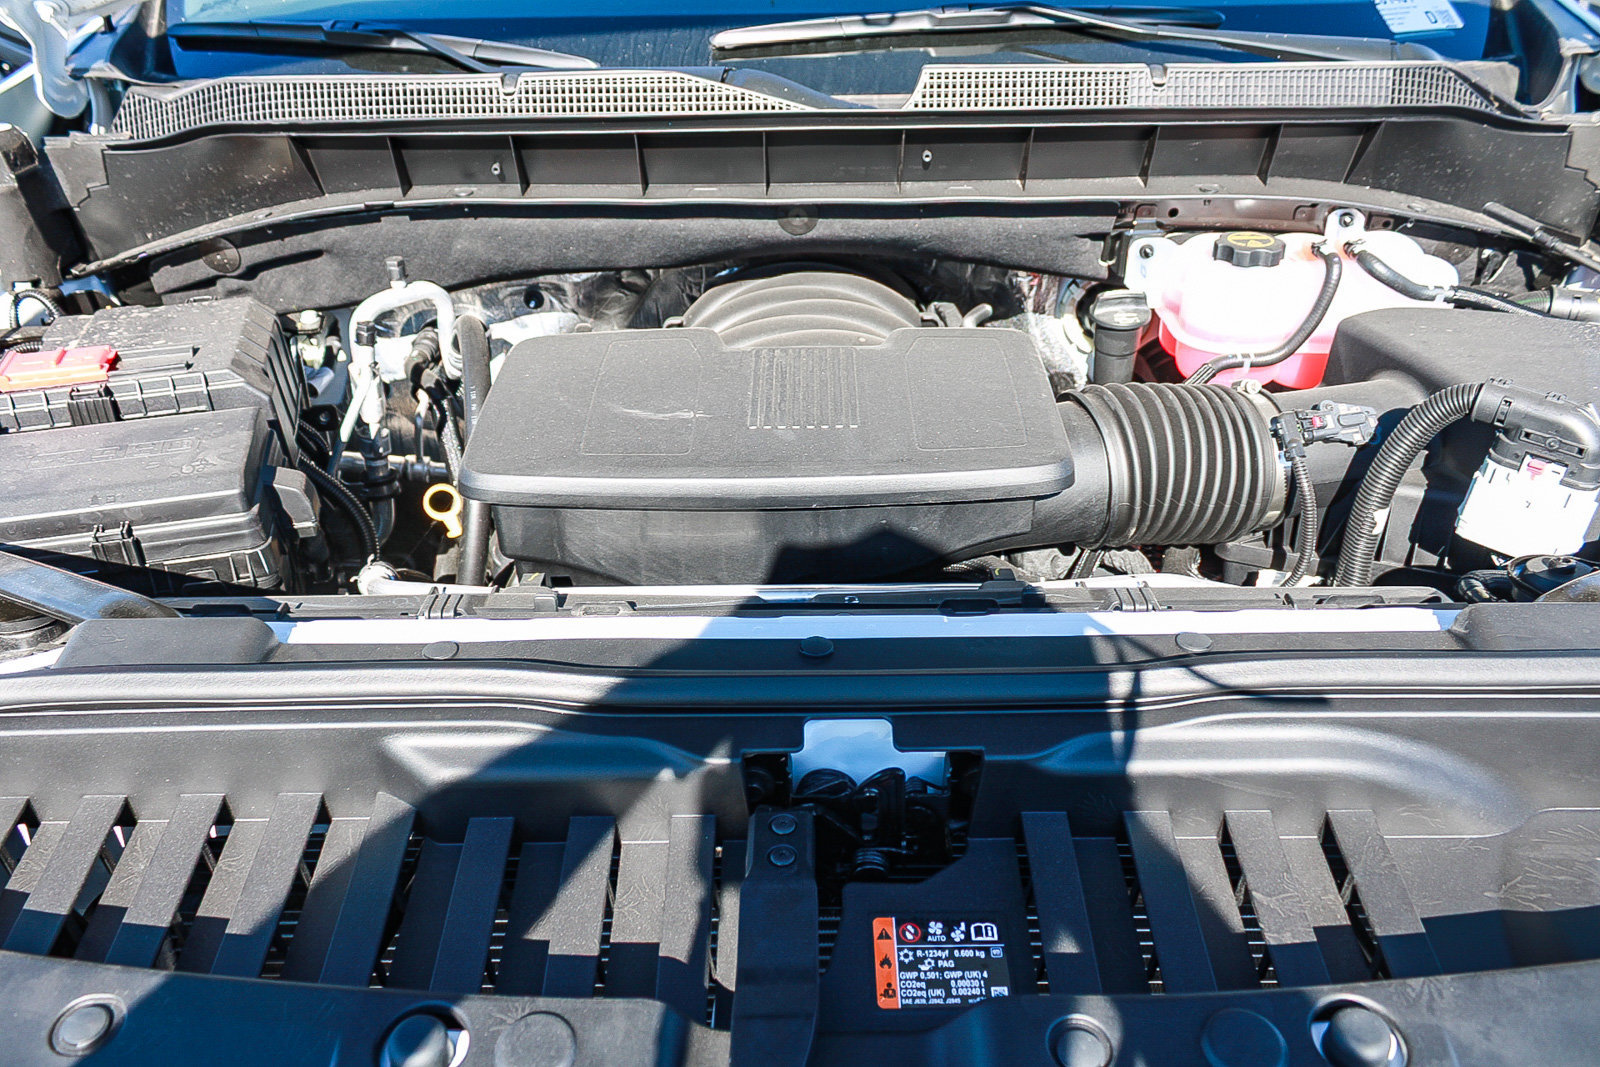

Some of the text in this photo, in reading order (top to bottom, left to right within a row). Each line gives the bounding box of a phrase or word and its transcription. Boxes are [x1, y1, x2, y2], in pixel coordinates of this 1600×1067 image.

[916, 949, 949, 958] R-1234yf
[976, 949, 985, 958] kg
[938, 960, 955, 968] PAG
[944, 971, 963, 979] GWP
[964, 971, 982, 980] (UK)
[900, 980, 926, 989] CO2eq
[901, 989, 927, 998] CO2eq
[928, 989, 946, 998] (UK)
